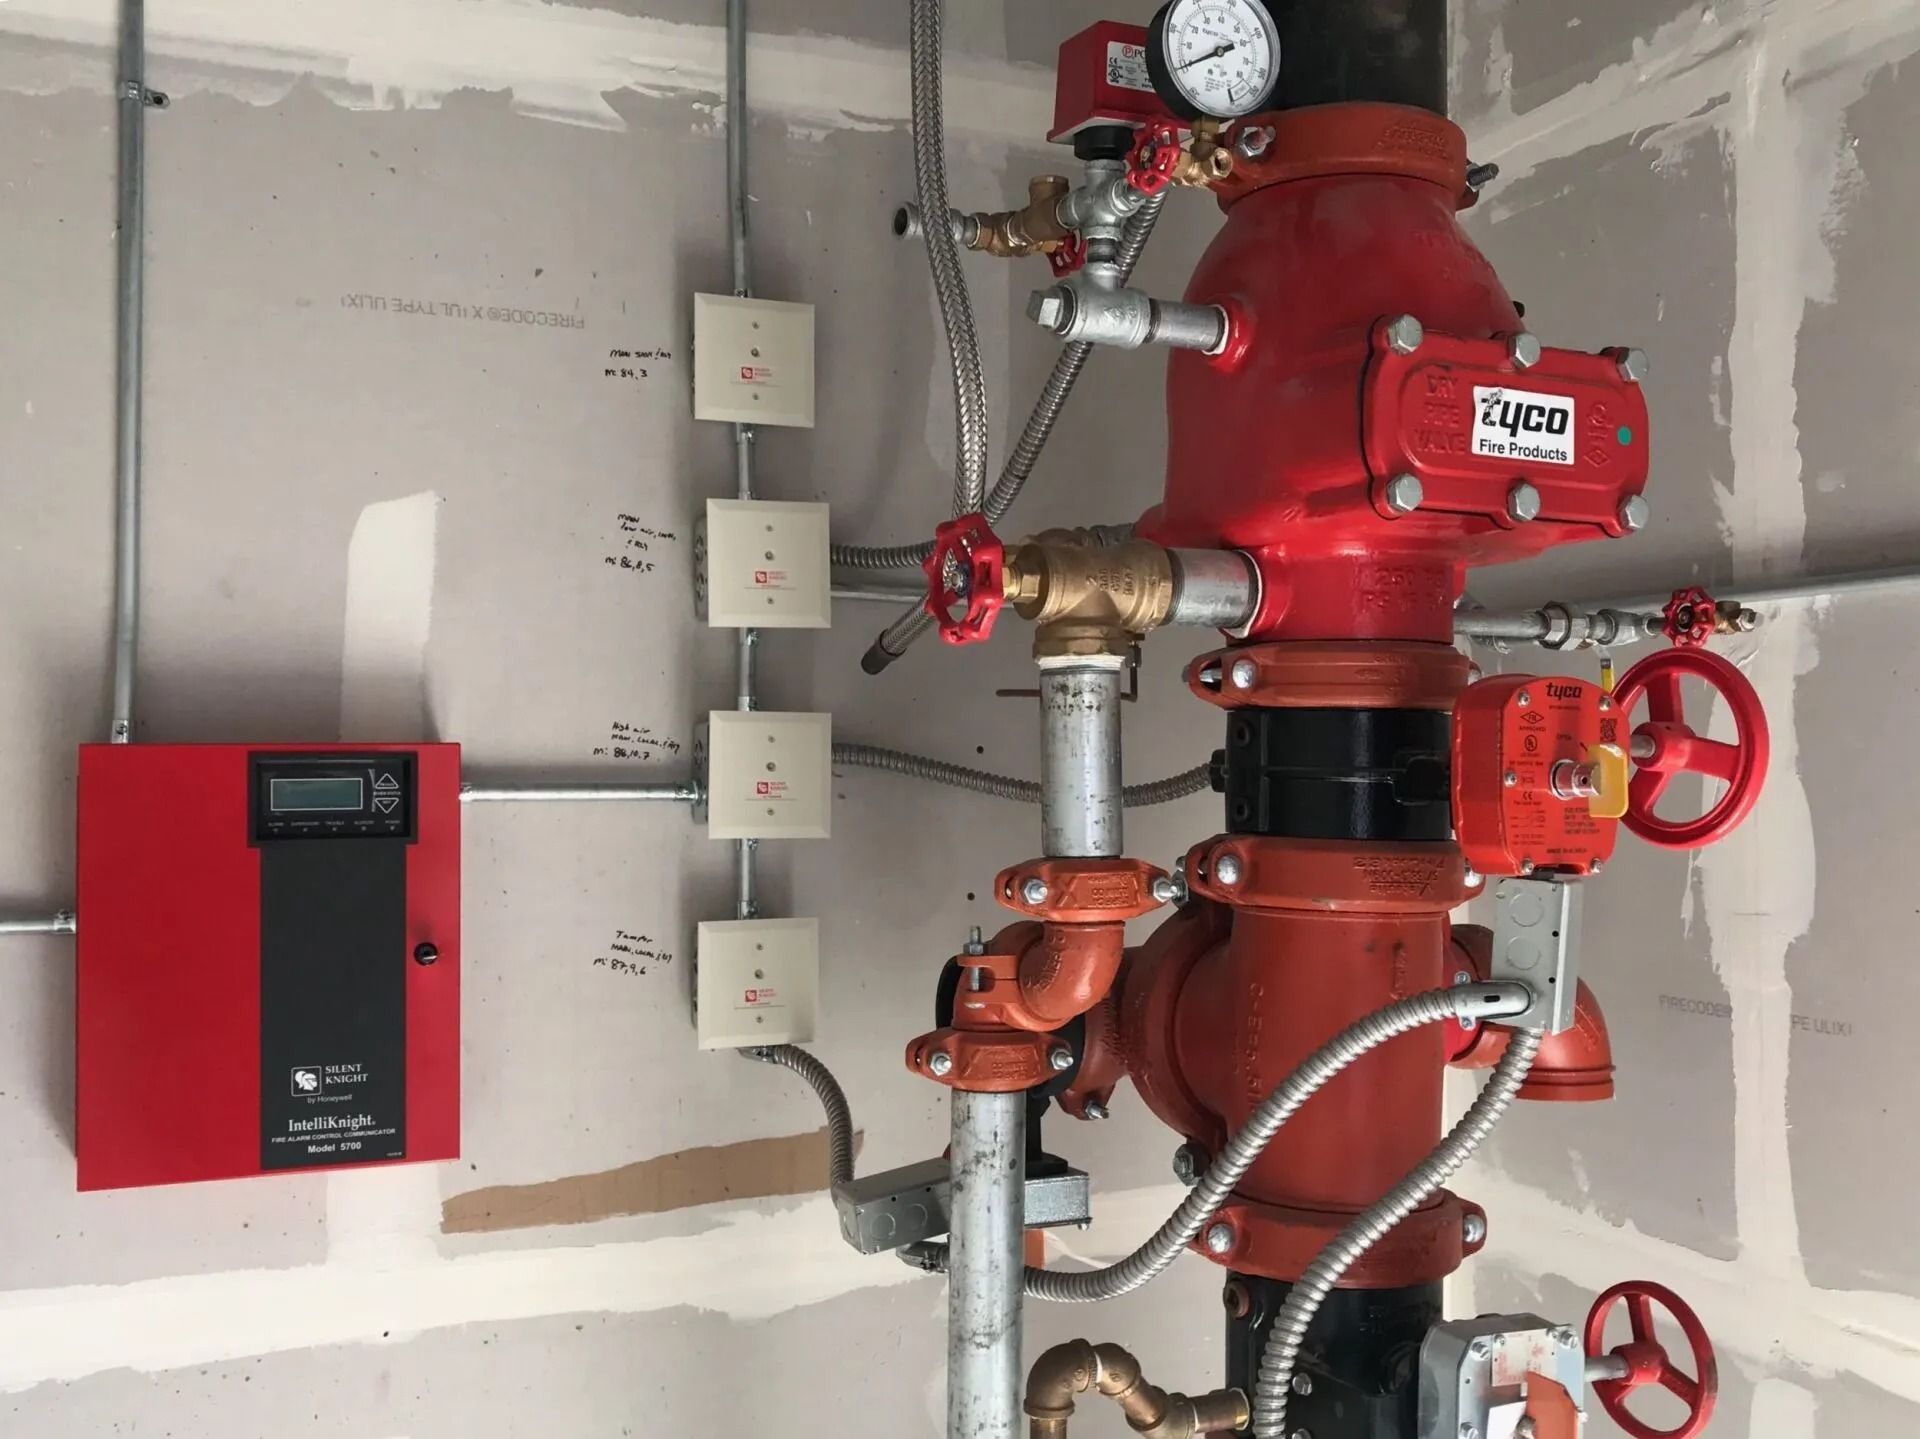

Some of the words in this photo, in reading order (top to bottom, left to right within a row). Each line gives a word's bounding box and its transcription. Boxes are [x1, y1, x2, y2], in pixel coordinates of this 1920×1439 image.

[391, 298, 437, 316] TYPE
[1425, 374, 1458, 399] DRY
[1480, 388, 1569, 438] tyco
[1479, 438, 1506, 455] Fire
[1509, 441, 1568, 462] Products
[1545, 682, 1582, 700] tyco
[325, 1063, 362, 1074] SILENT
[325, 1073, 368, 1085] KNIGHT
[307, 1096, 315, 1104] by
[317, 1094, 352, 1103] Honeywell
[288, 1134, 311, 1142] ALARM
[312, 1132, 342, 1140] CONTROL
[344, 1128, 396, 1138] COMMUNICATOR
[308, 1144, 335, 1153] Model
[340, 1142, 361, 1151] 5700
